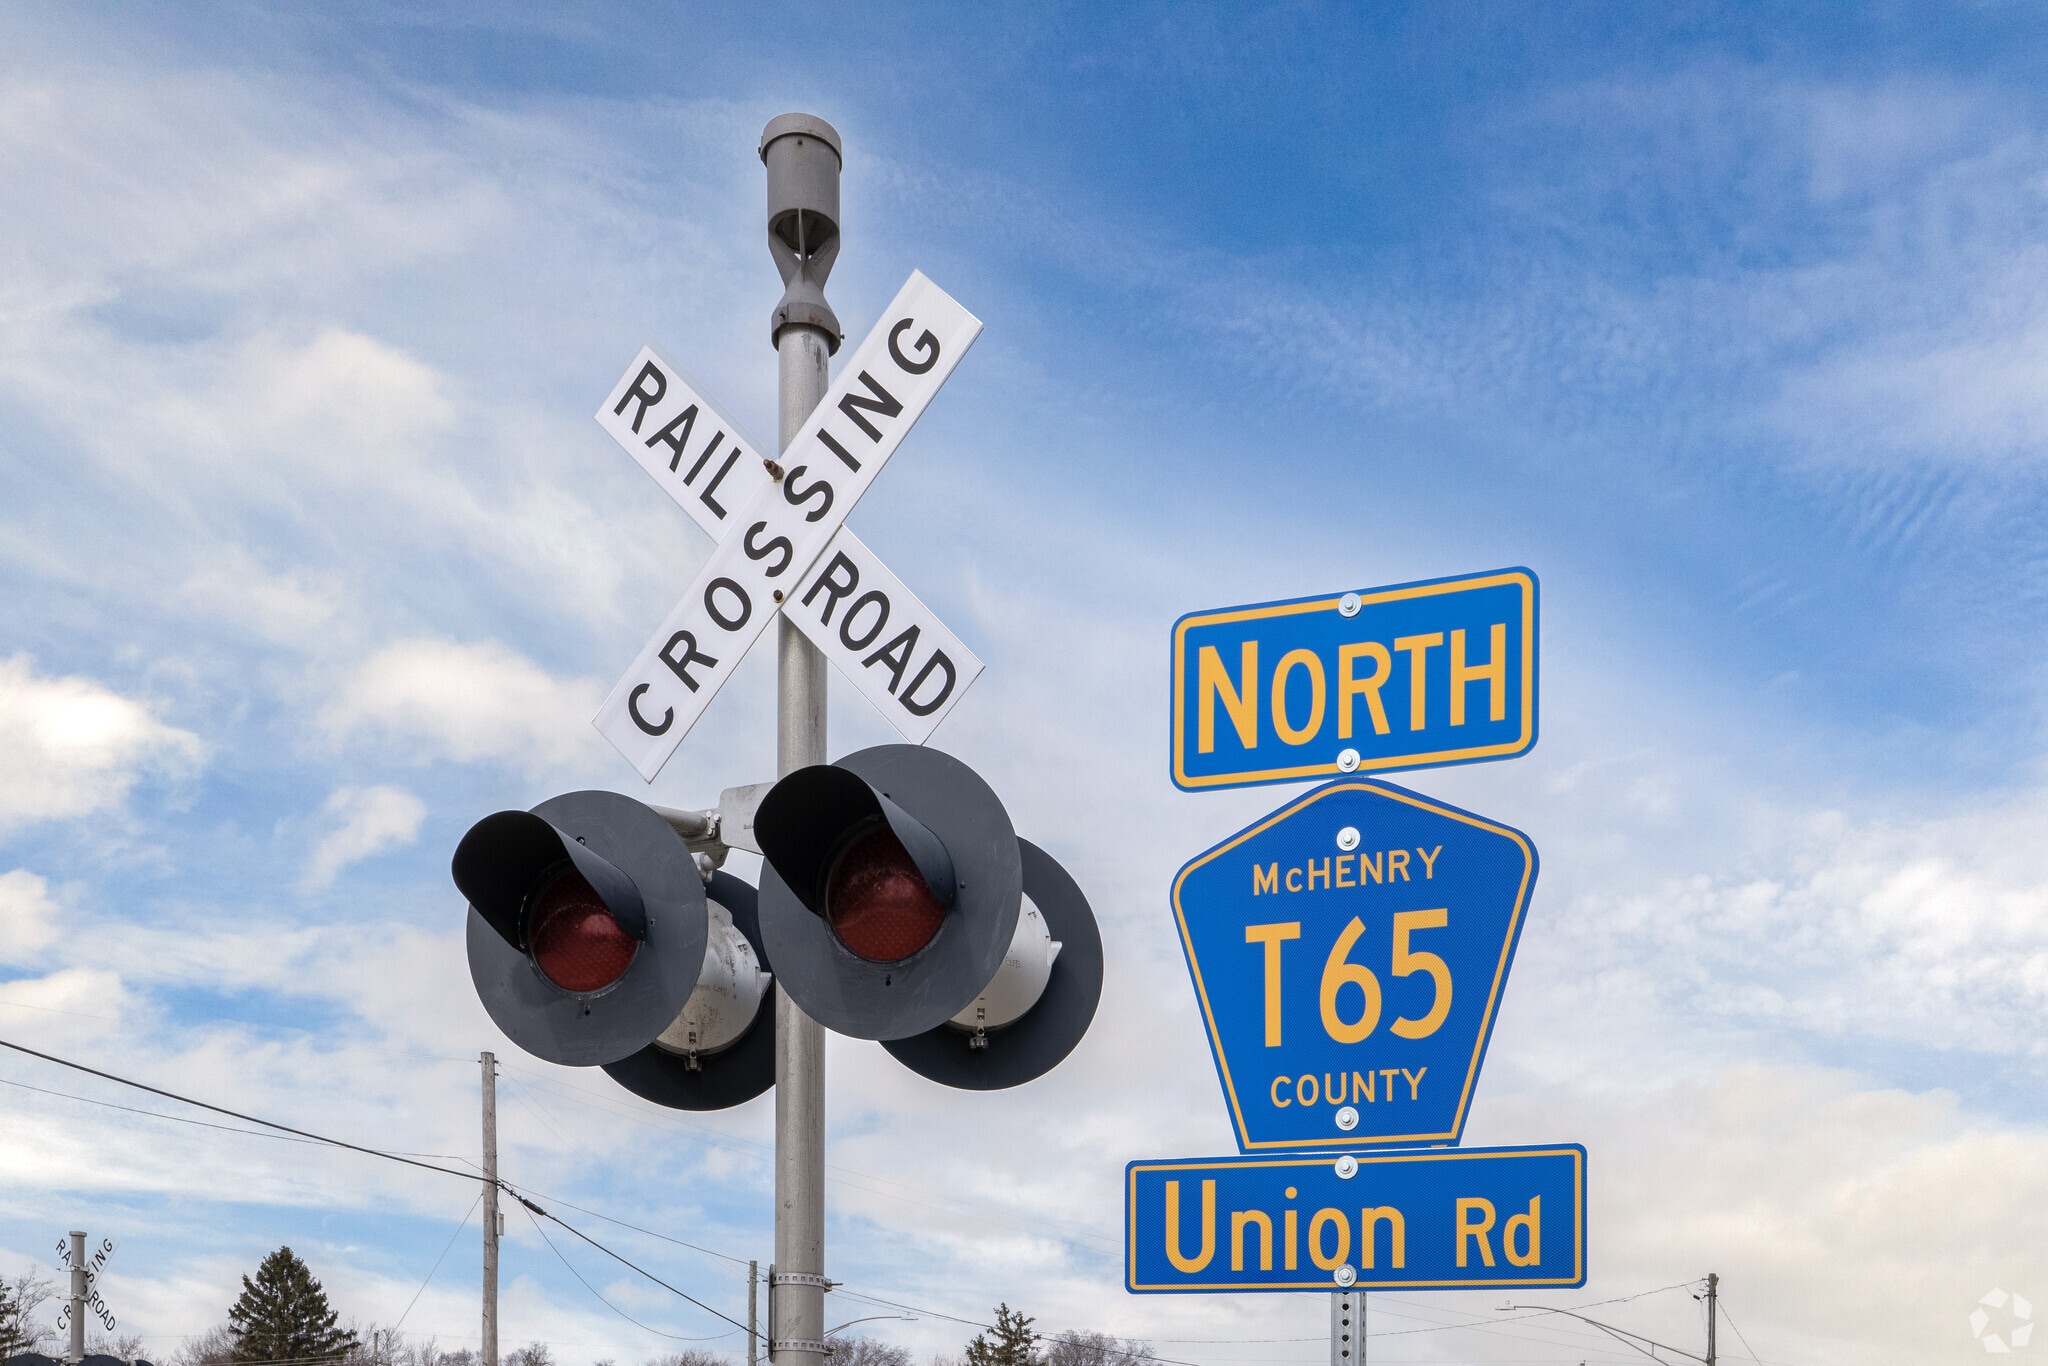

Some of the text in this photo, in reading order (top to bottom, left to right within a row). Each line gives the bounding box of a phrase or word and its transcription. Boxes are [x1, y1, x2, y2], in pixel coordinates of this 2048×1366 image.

[613, 359, 957, 717] RAIL ROAD
[628, 317, 941, 737] CROSSING
[1197, 622, 1506, 754] NORTH
[1253, 845, 1443, 895] McHENRY
[1245, 907, 1454, 1047] T65
[1271, 1067, 1428, 1108] COUNTY
[1165, 1177, 1541, 1273] Union Rd
[88, 1290, 116, 1332] ROAD
